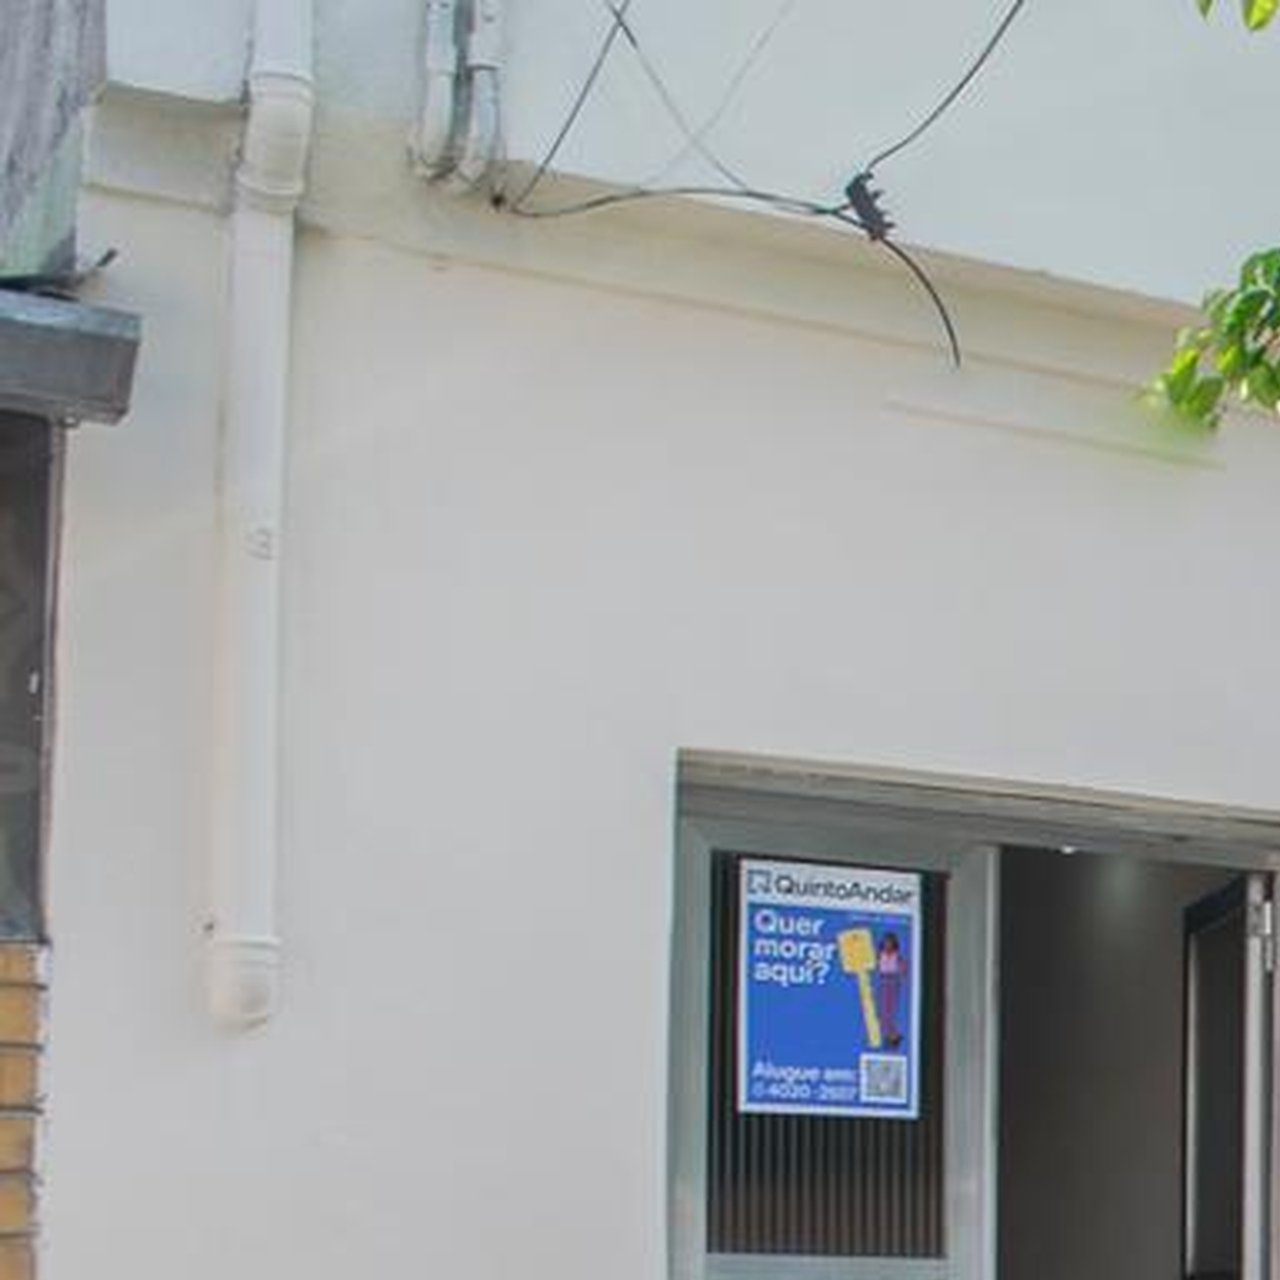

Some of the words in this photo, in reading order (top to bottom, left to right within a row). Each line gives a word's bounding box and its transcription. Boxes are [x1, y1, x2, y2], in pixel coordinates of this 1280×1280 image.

[774, 873, 915, 904] QuintoAndar
[753, 909, 824, 936] Quer
[753, 937, 837, 961] morar
[753, 958, 830, 988] aqui?
